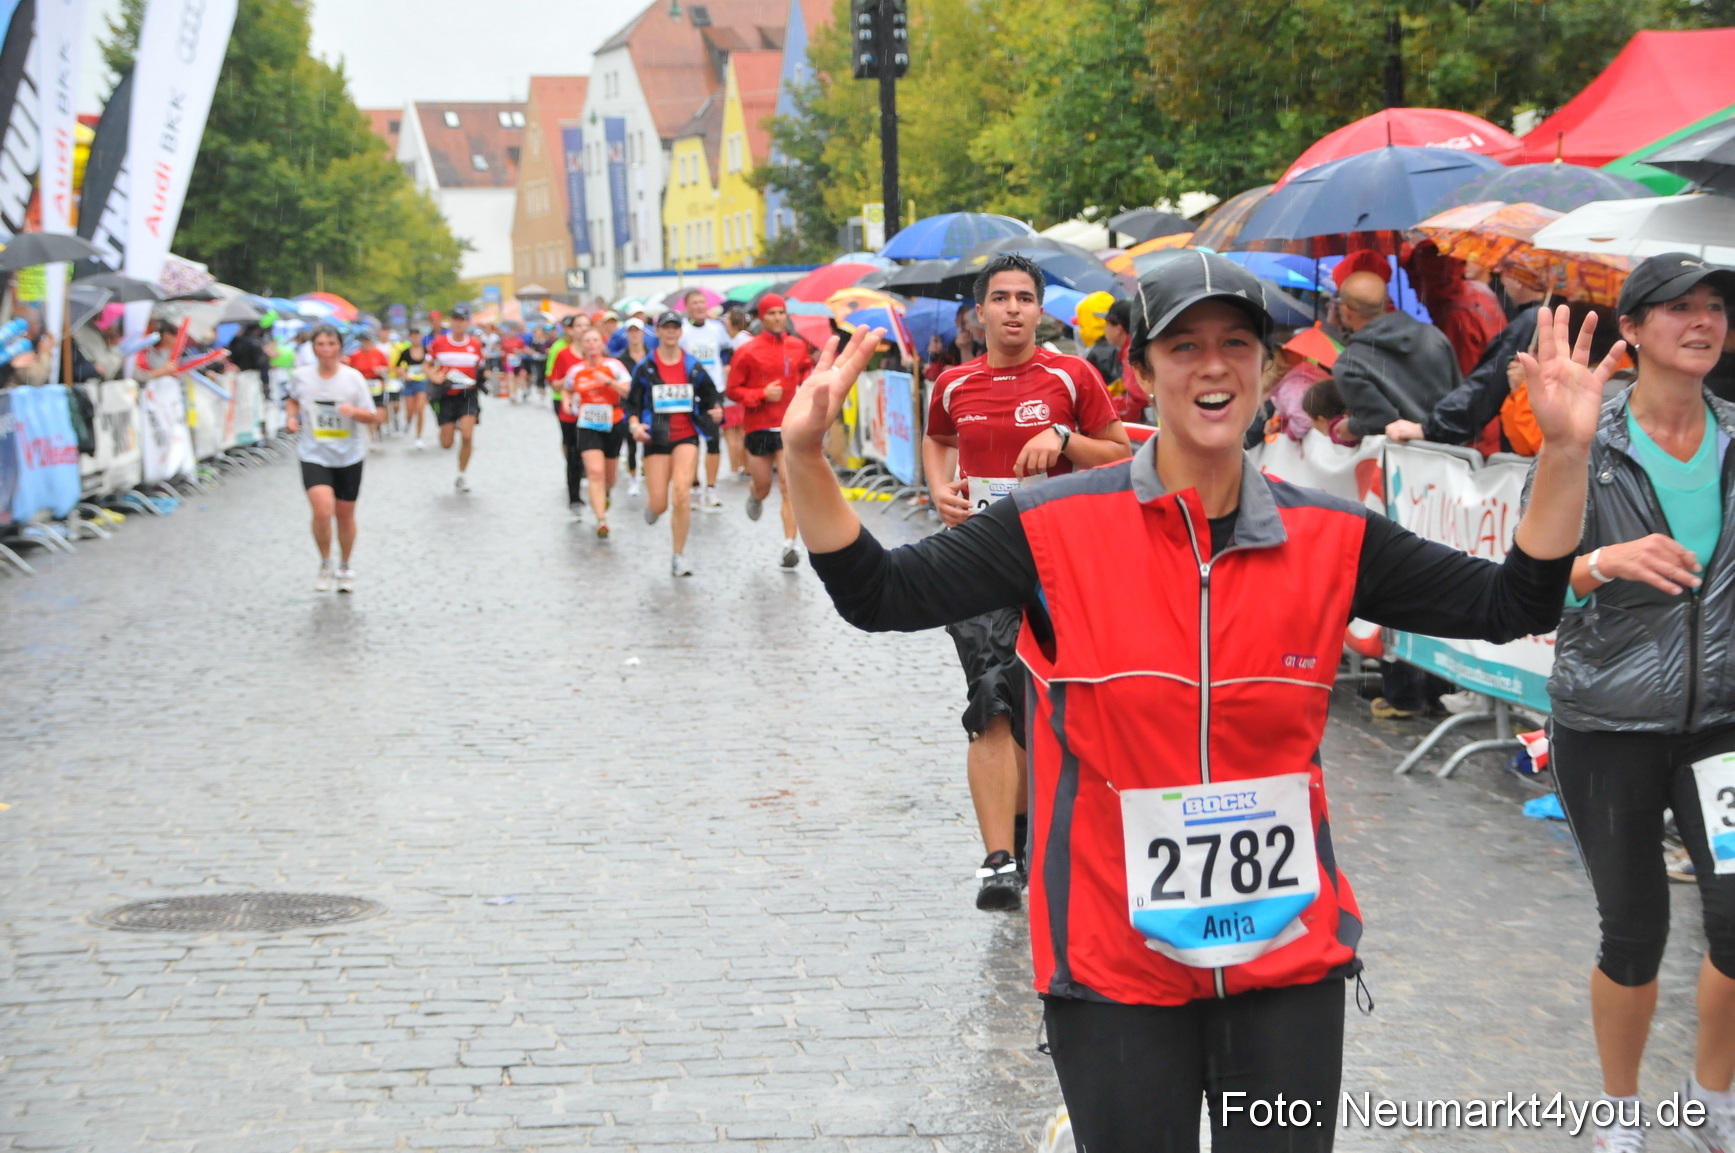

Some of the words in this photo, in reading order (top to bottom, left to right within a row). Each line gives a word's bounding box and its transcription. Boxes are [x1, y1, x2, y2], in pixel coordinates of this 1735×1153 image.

[145, 160, 172, 239] Audi
[160, 86, 188, 154] BKK
[657, 384, 689, 399] 2473
[1183, 791, 1257, 815] BOCK
[1147, 824, 1299, 902] 2782
[1203, 914, 1256, 943] Anja
